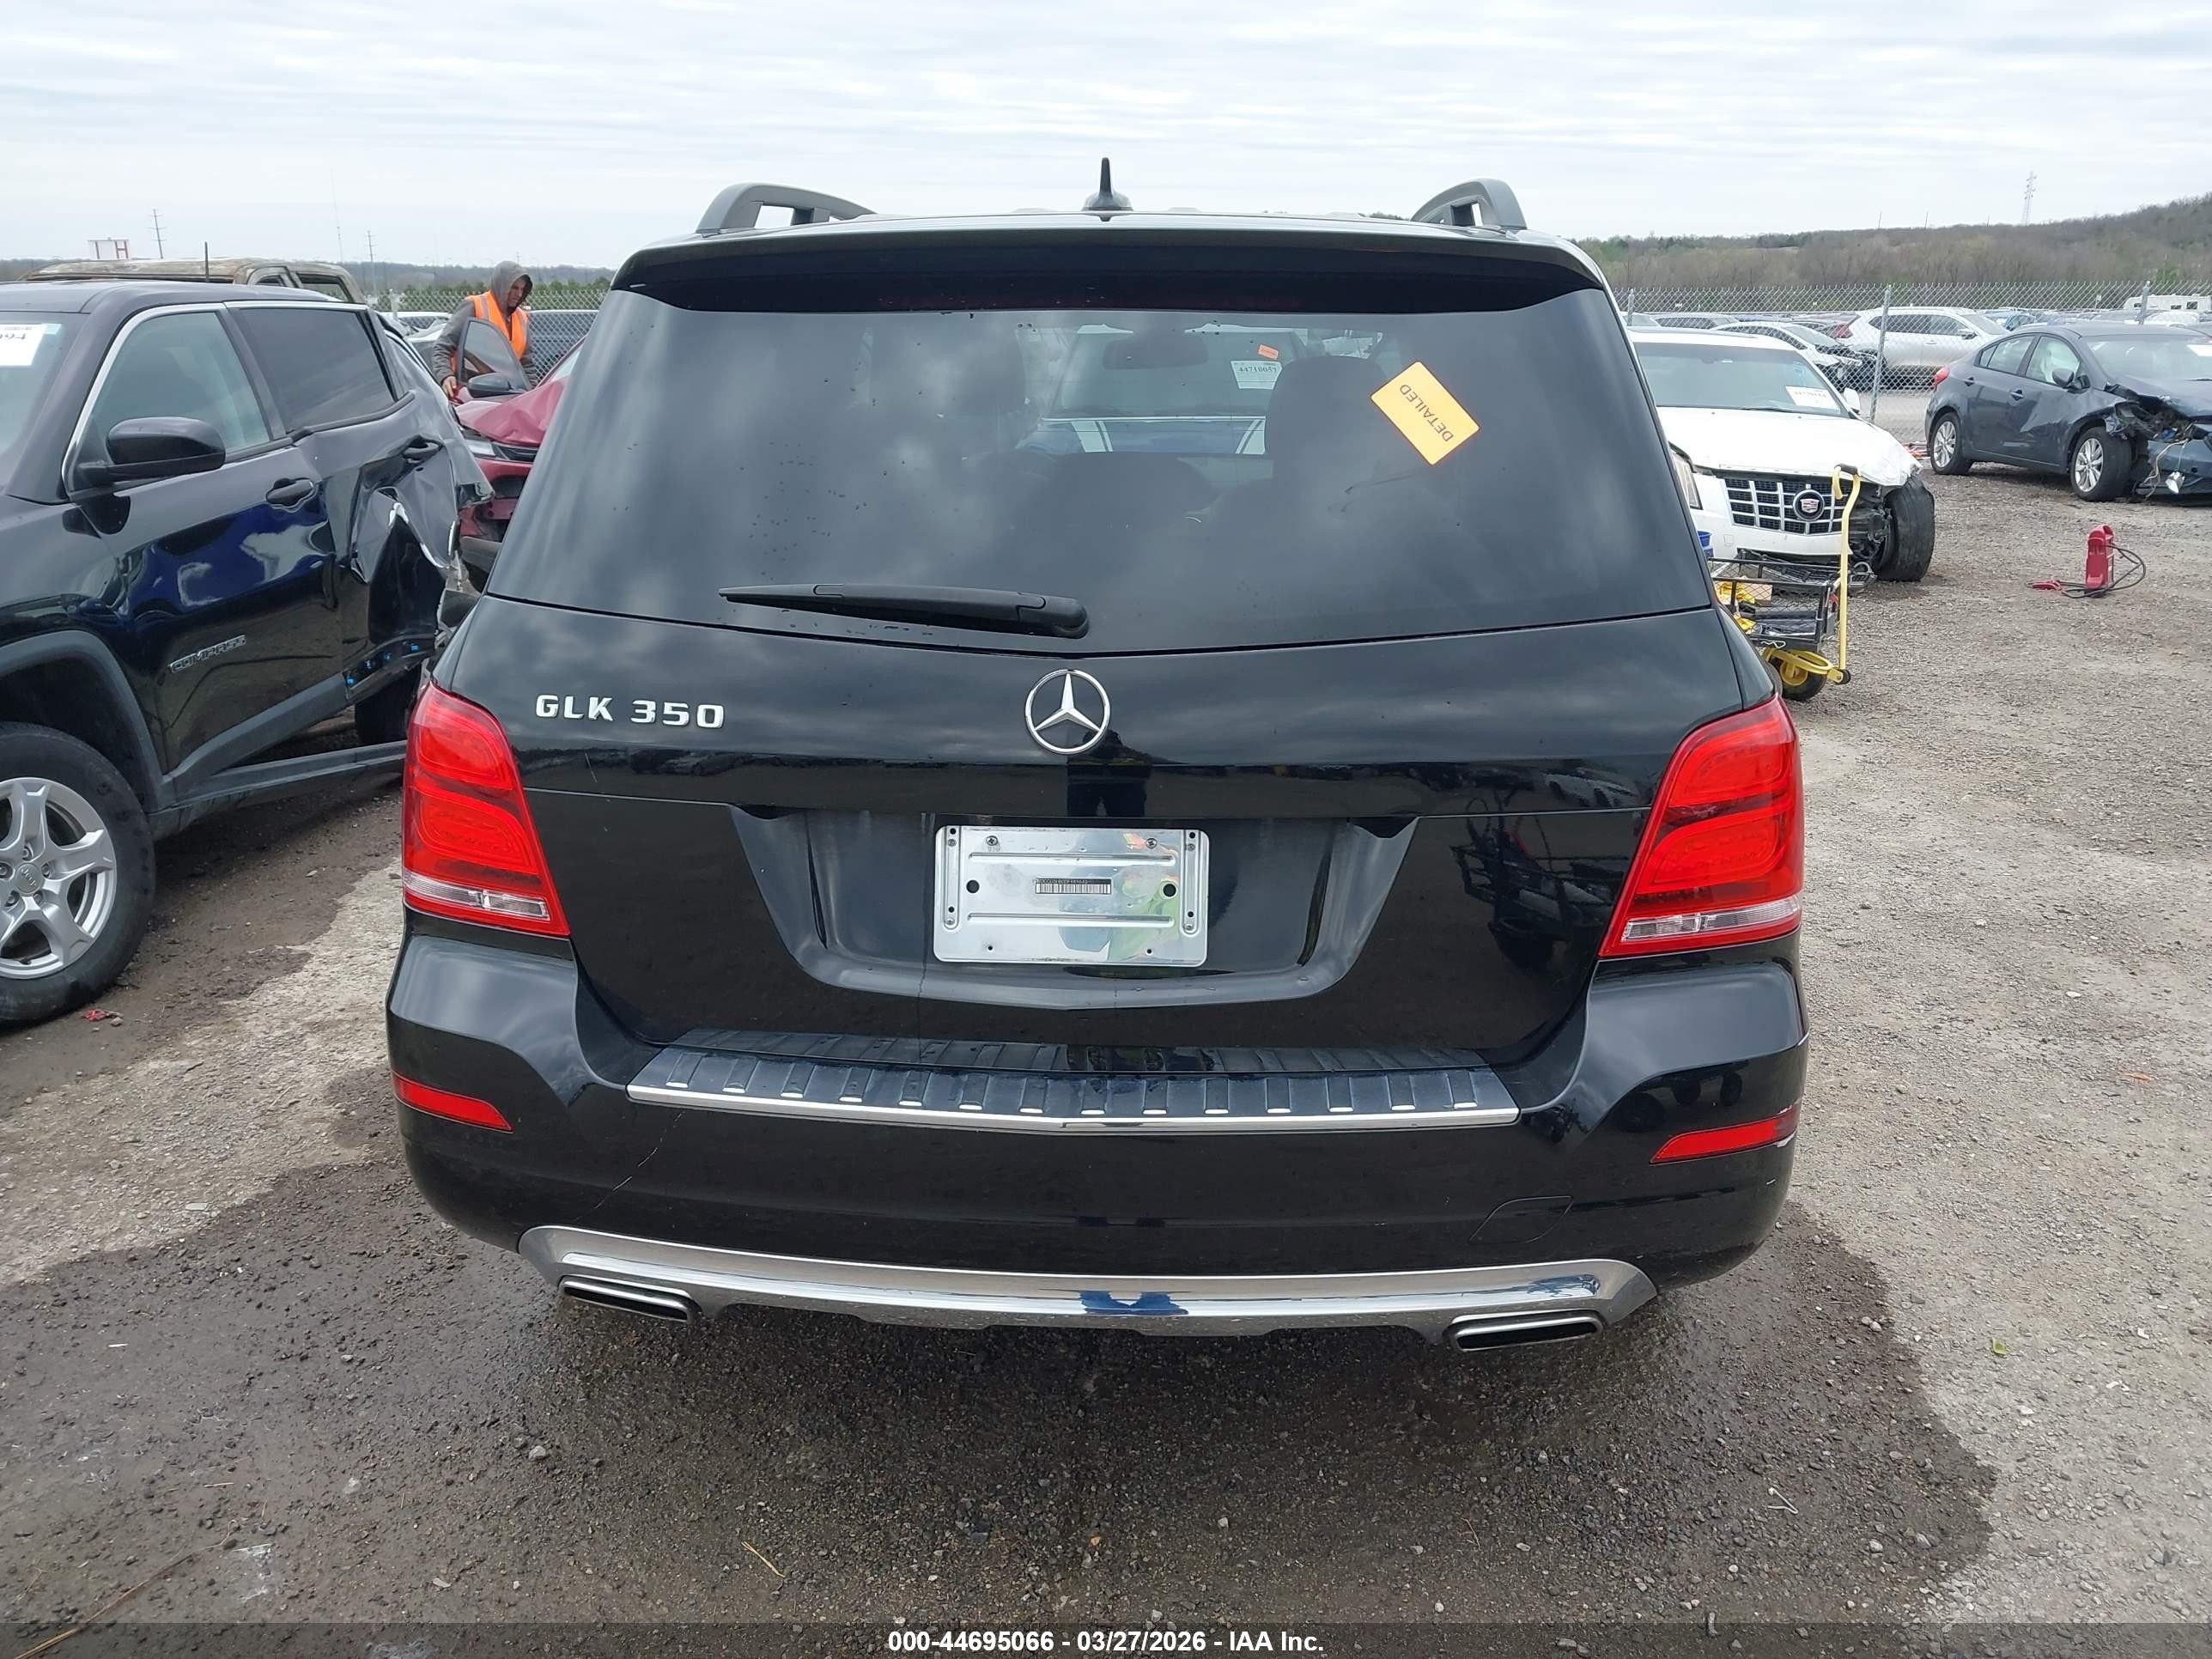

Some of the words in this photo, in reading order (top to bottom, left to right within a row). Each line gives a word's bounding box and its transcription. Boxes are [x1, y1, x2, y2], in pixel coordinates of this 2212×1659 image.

[1400, 384, 1454, 441] DETAILED
[169, 635, 246, 673] COMPASS
[536, 694, 614, 721] GLK
[630, 700, 725, 728] 350
